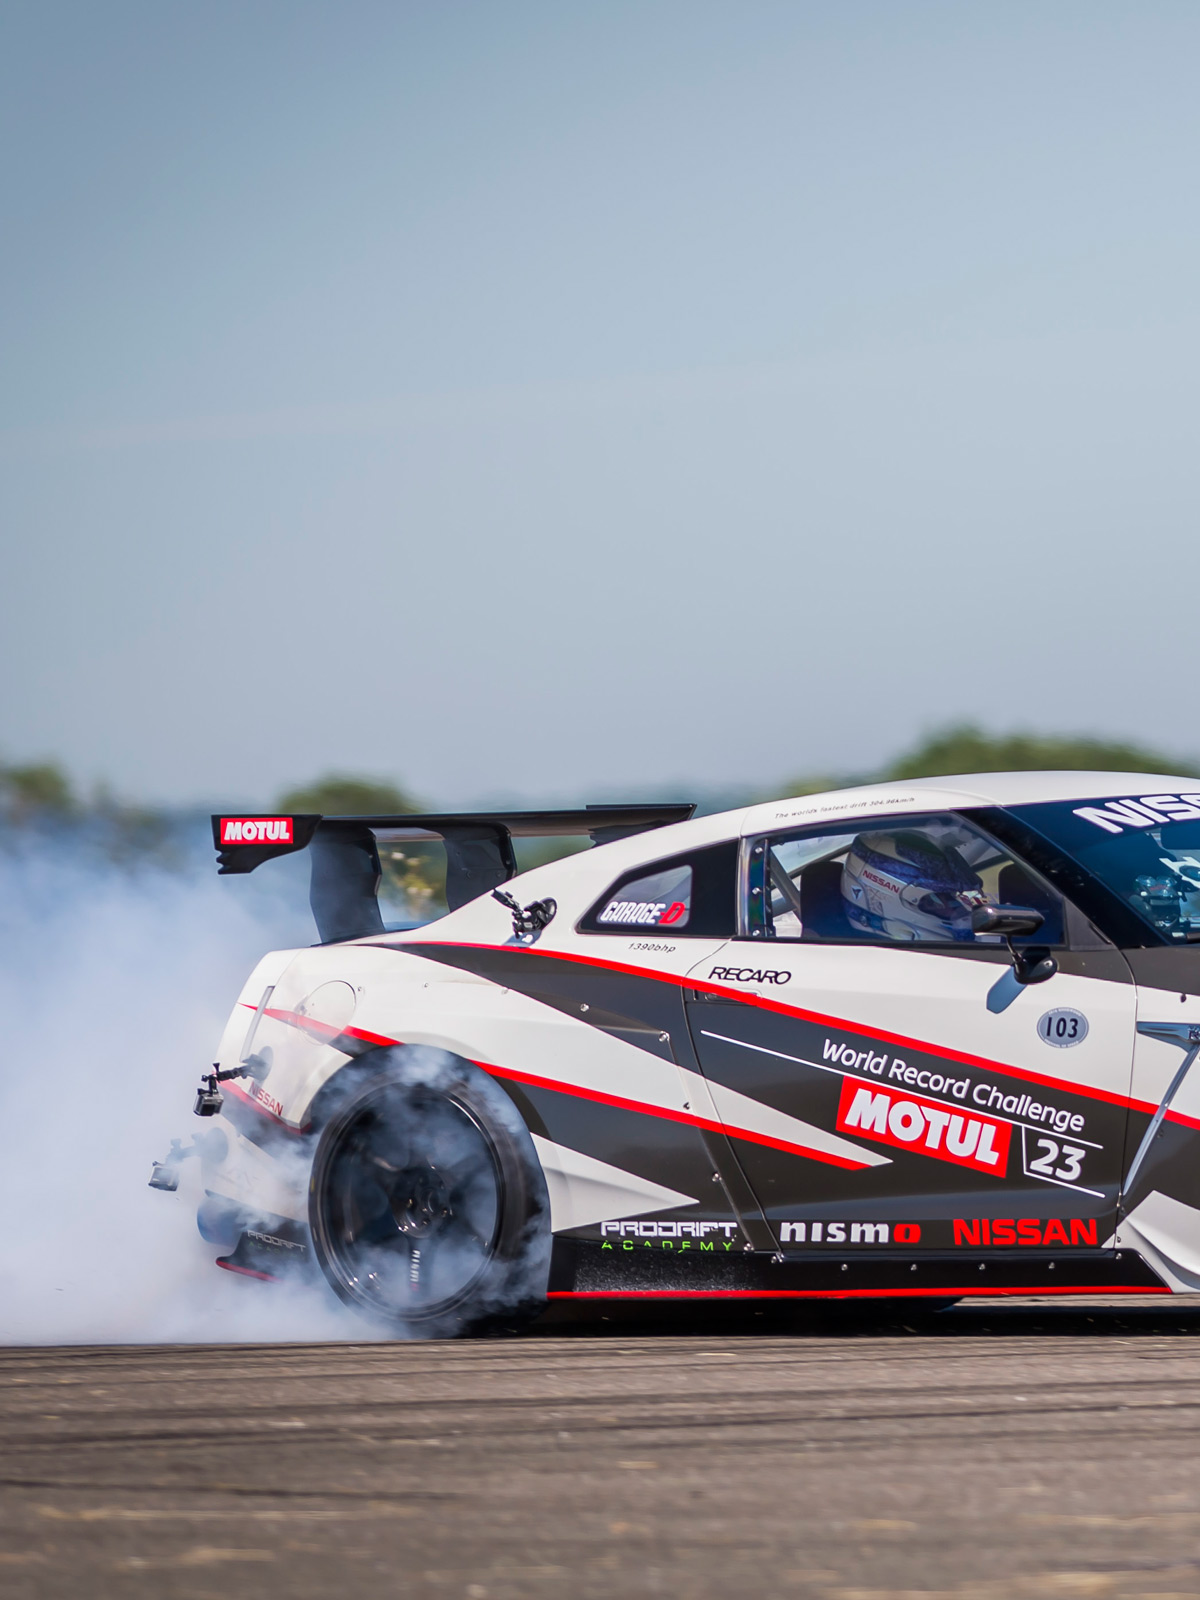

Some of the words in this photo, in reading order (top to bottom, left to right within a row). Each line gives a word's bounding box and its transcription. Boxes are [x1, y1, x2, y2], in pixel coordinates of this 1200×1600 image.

[223, 821, 290, 841] MOTUL
[862, 870, 900, 894] NISSAN
[600, 901, 686, 925] GARAGE-D
[628, 942, 677, 954] 1390bhp
[708, 966, 792, 985] RECARO
[1046, 1016, 1079, 1039] 103
[822, 1038, 888, 1075] World
[888, 1058, 970, 1099] Record
[972, 1083, 1085, 1133] Challenge
[249, 1080, 284, 1117] NISSAN
[844, 1087, 1000, 1166] MOTUL
[1029, 1138, 1087, 1182] 23
[247, 1229, 307, 1252] PRODRIFT
[600, 1221, 738, 1237] PRODRIFT
[779, 1222, 921, 1245] nismo
[952, 1218, 1098, 1246] NISSAN
